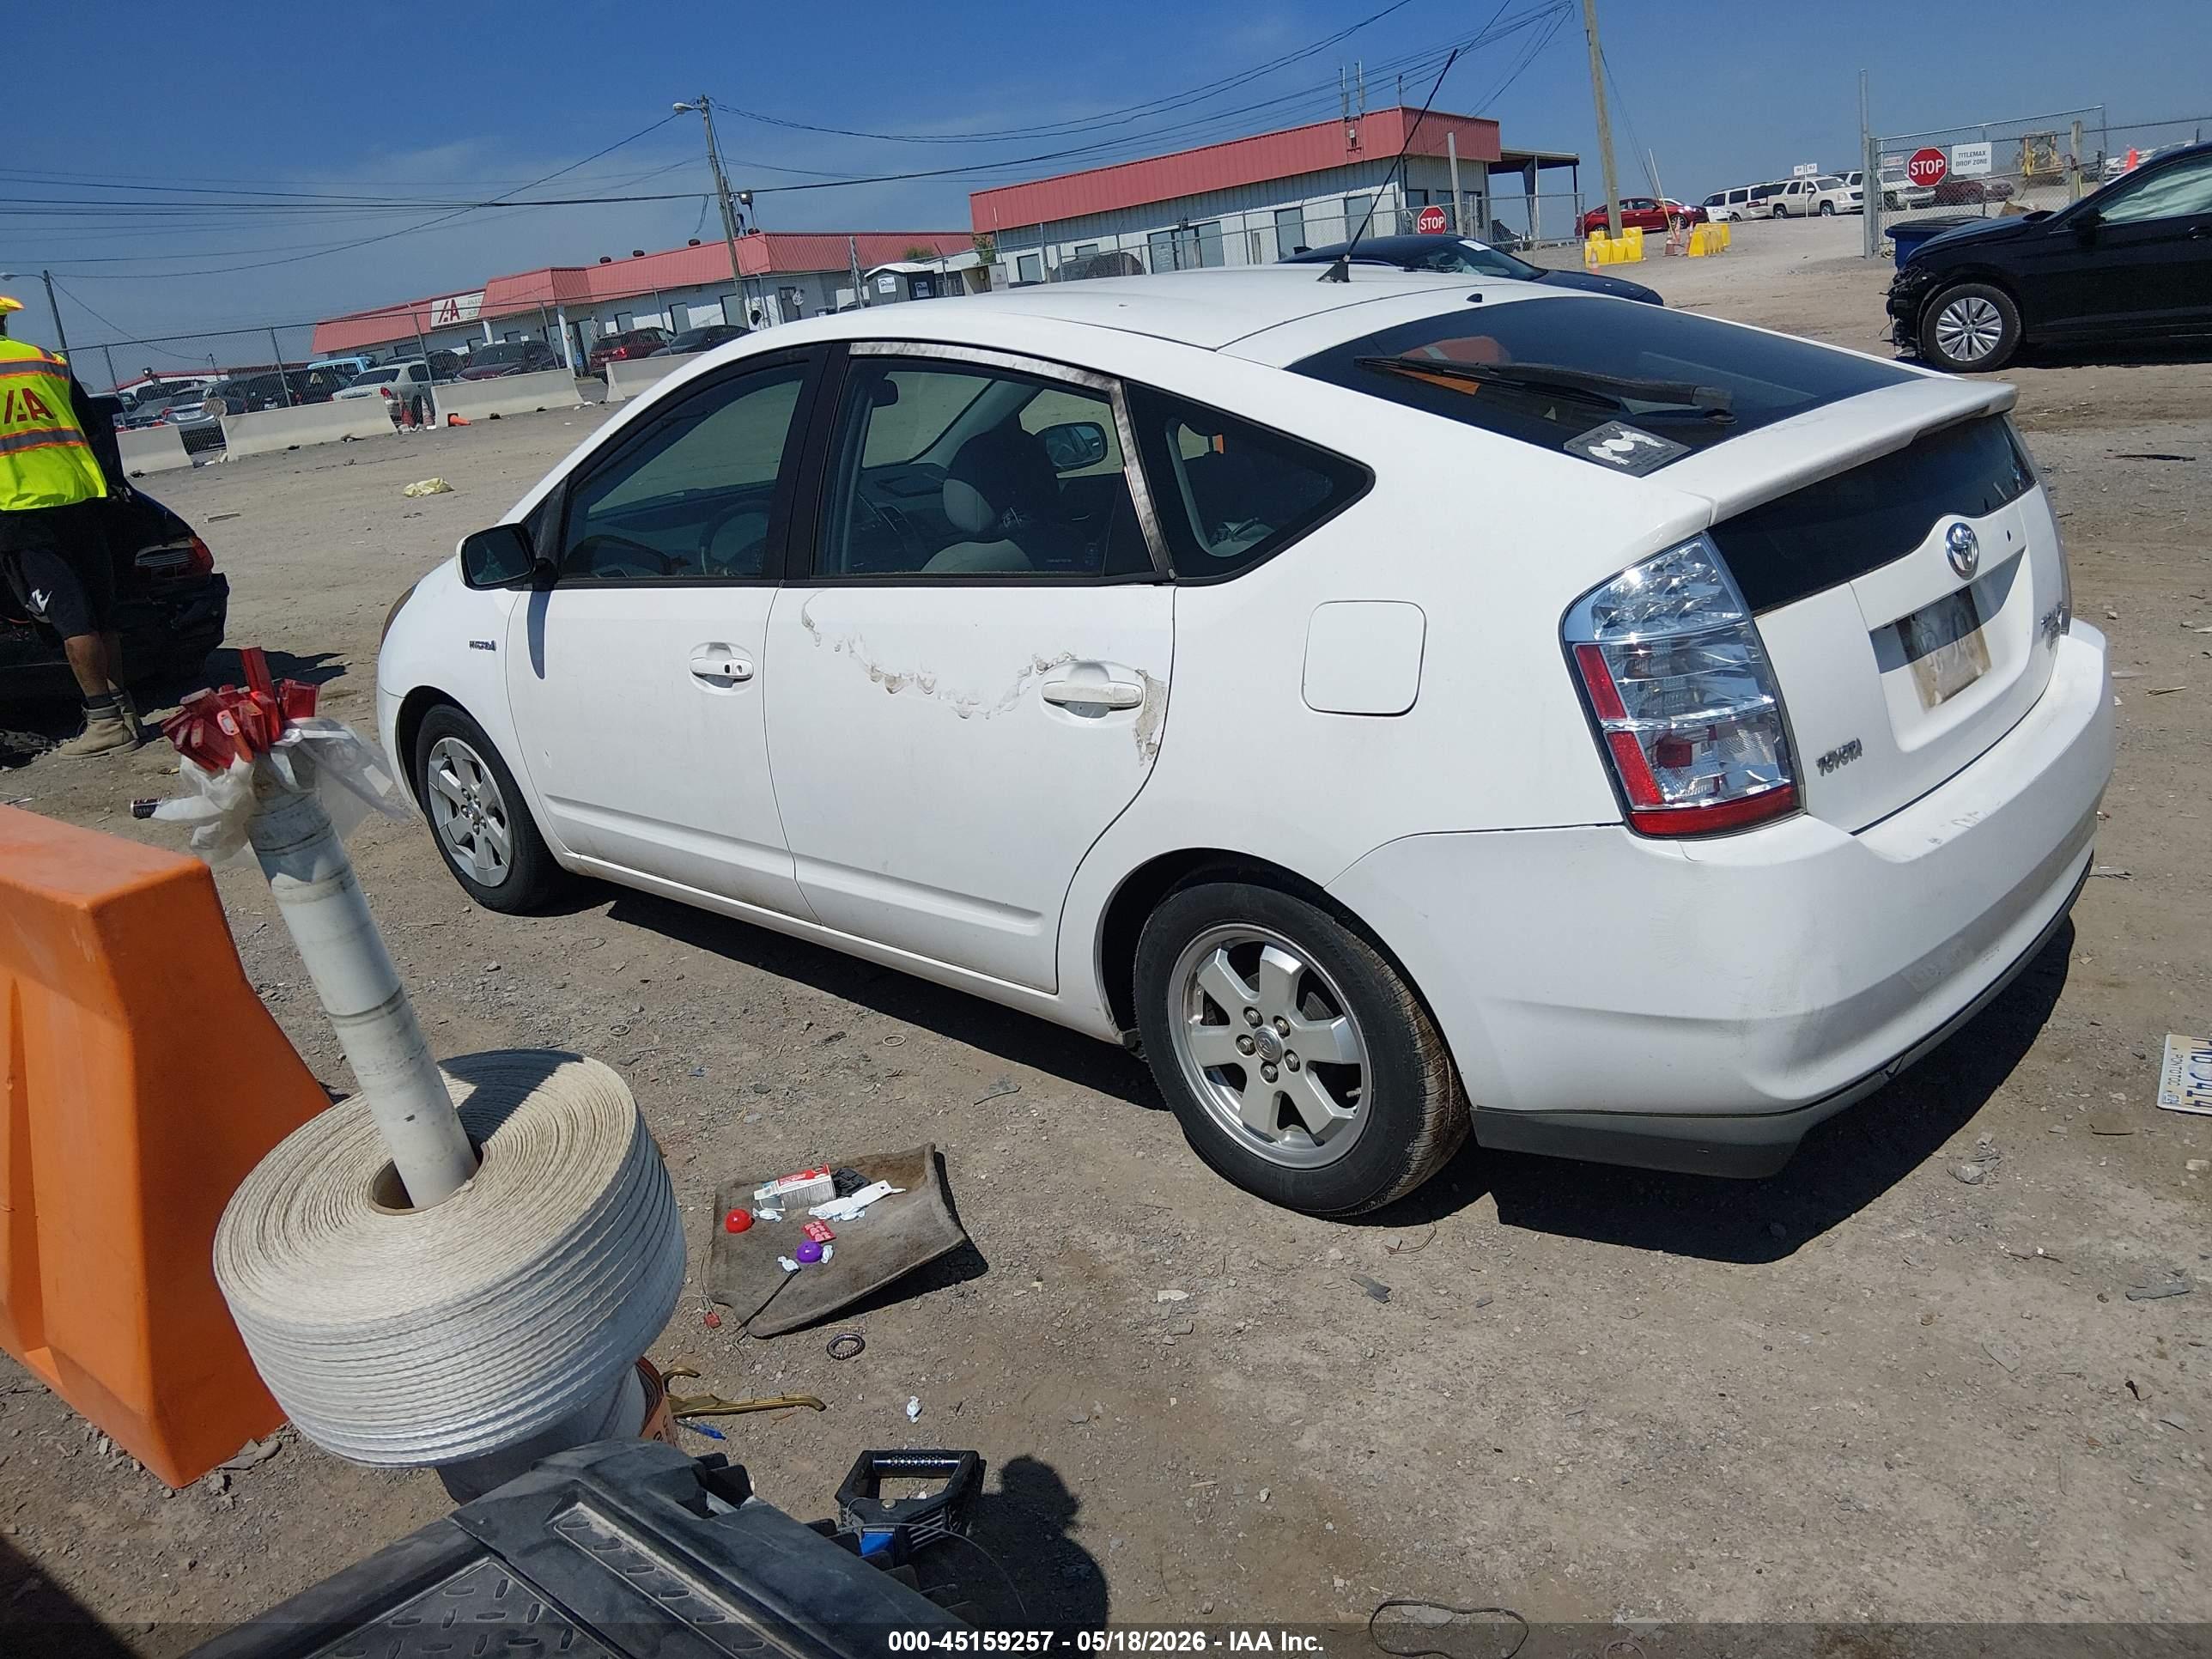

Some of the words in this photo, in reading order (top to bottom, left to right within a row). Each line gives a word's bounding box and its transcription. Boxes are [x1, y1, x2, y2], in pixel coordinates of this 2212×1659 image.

[1958, 150, 1986, 159] TITLEMAX
[1910, 159, 1944, 176] STOP
[1419, 216, 1444, 231] STOP
[1815, 738, 1863, 777] TOYOTA
